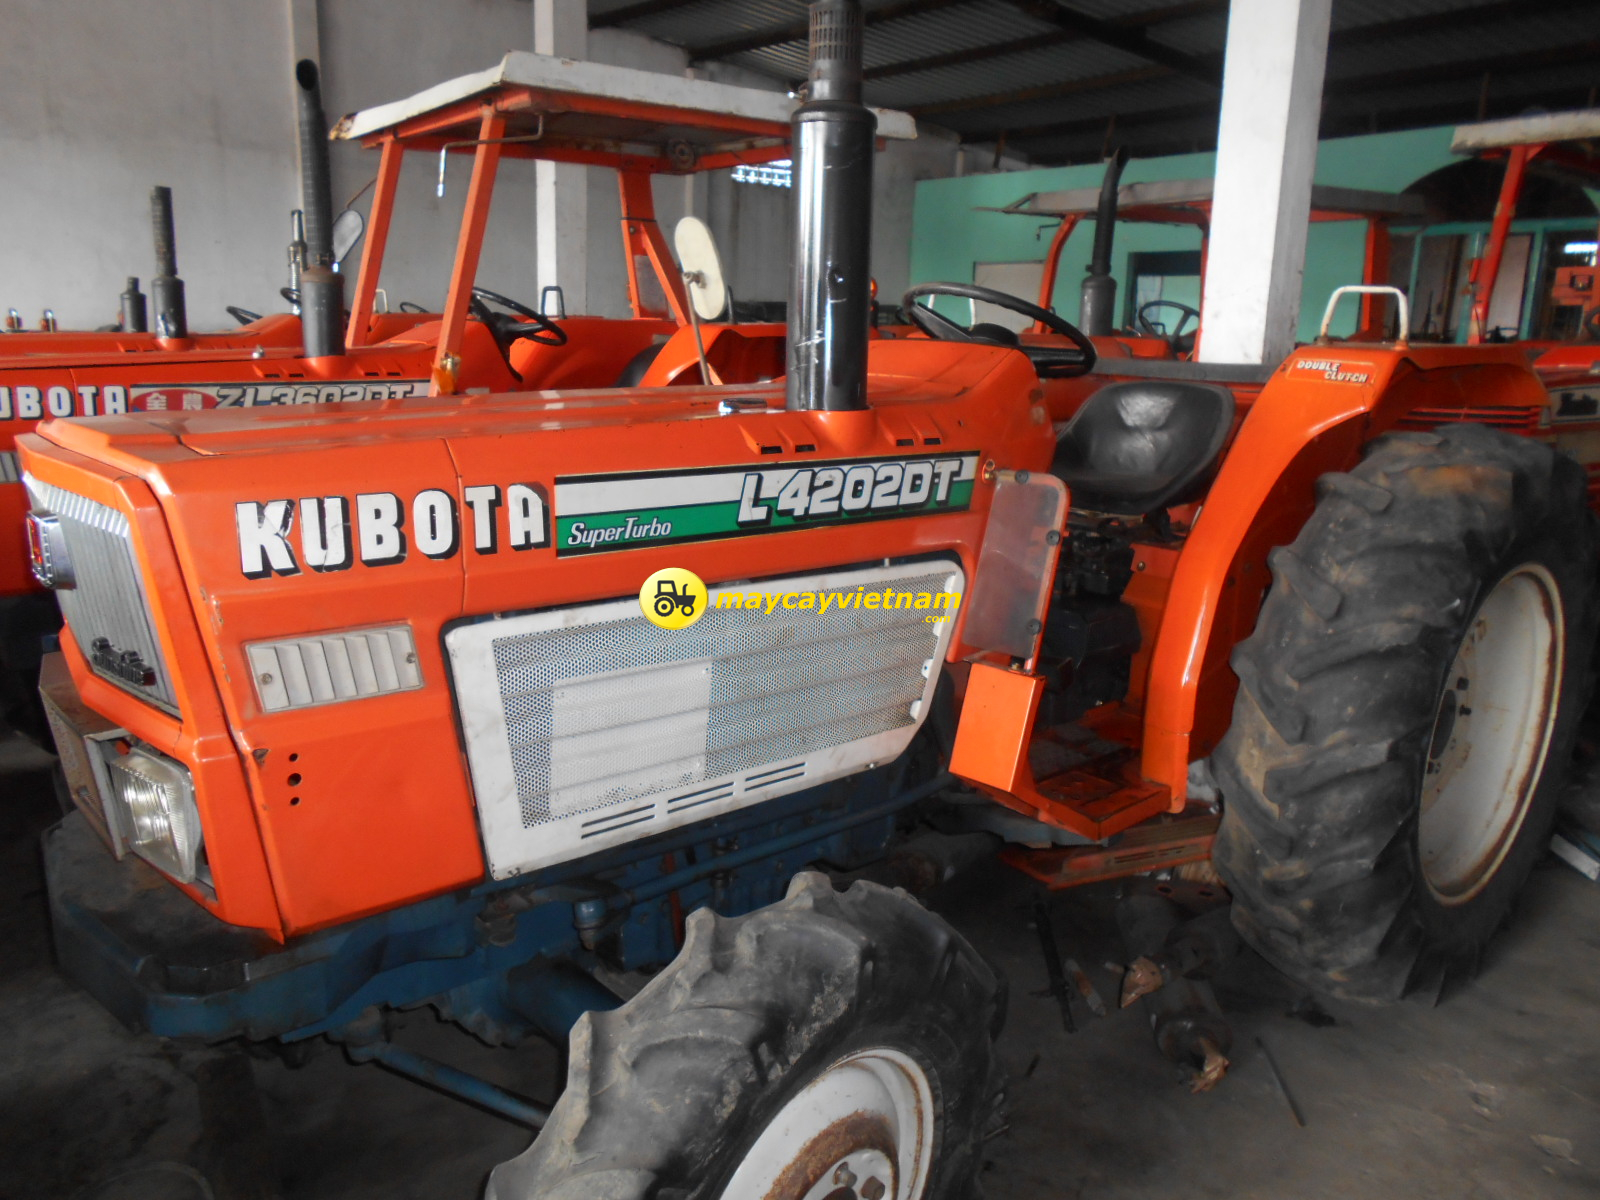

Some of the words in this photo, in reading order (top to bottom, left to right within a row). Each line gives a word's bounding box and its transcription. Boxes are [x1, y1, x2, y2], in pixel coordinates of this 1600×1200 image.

[1297, 360, 1341, 372] DOUBLE
[1324, 371, 1369, 383] CLUTCH
[737, 458, 963, 528] L4202DT
[236, 482, 551, 580] KUBOTA
